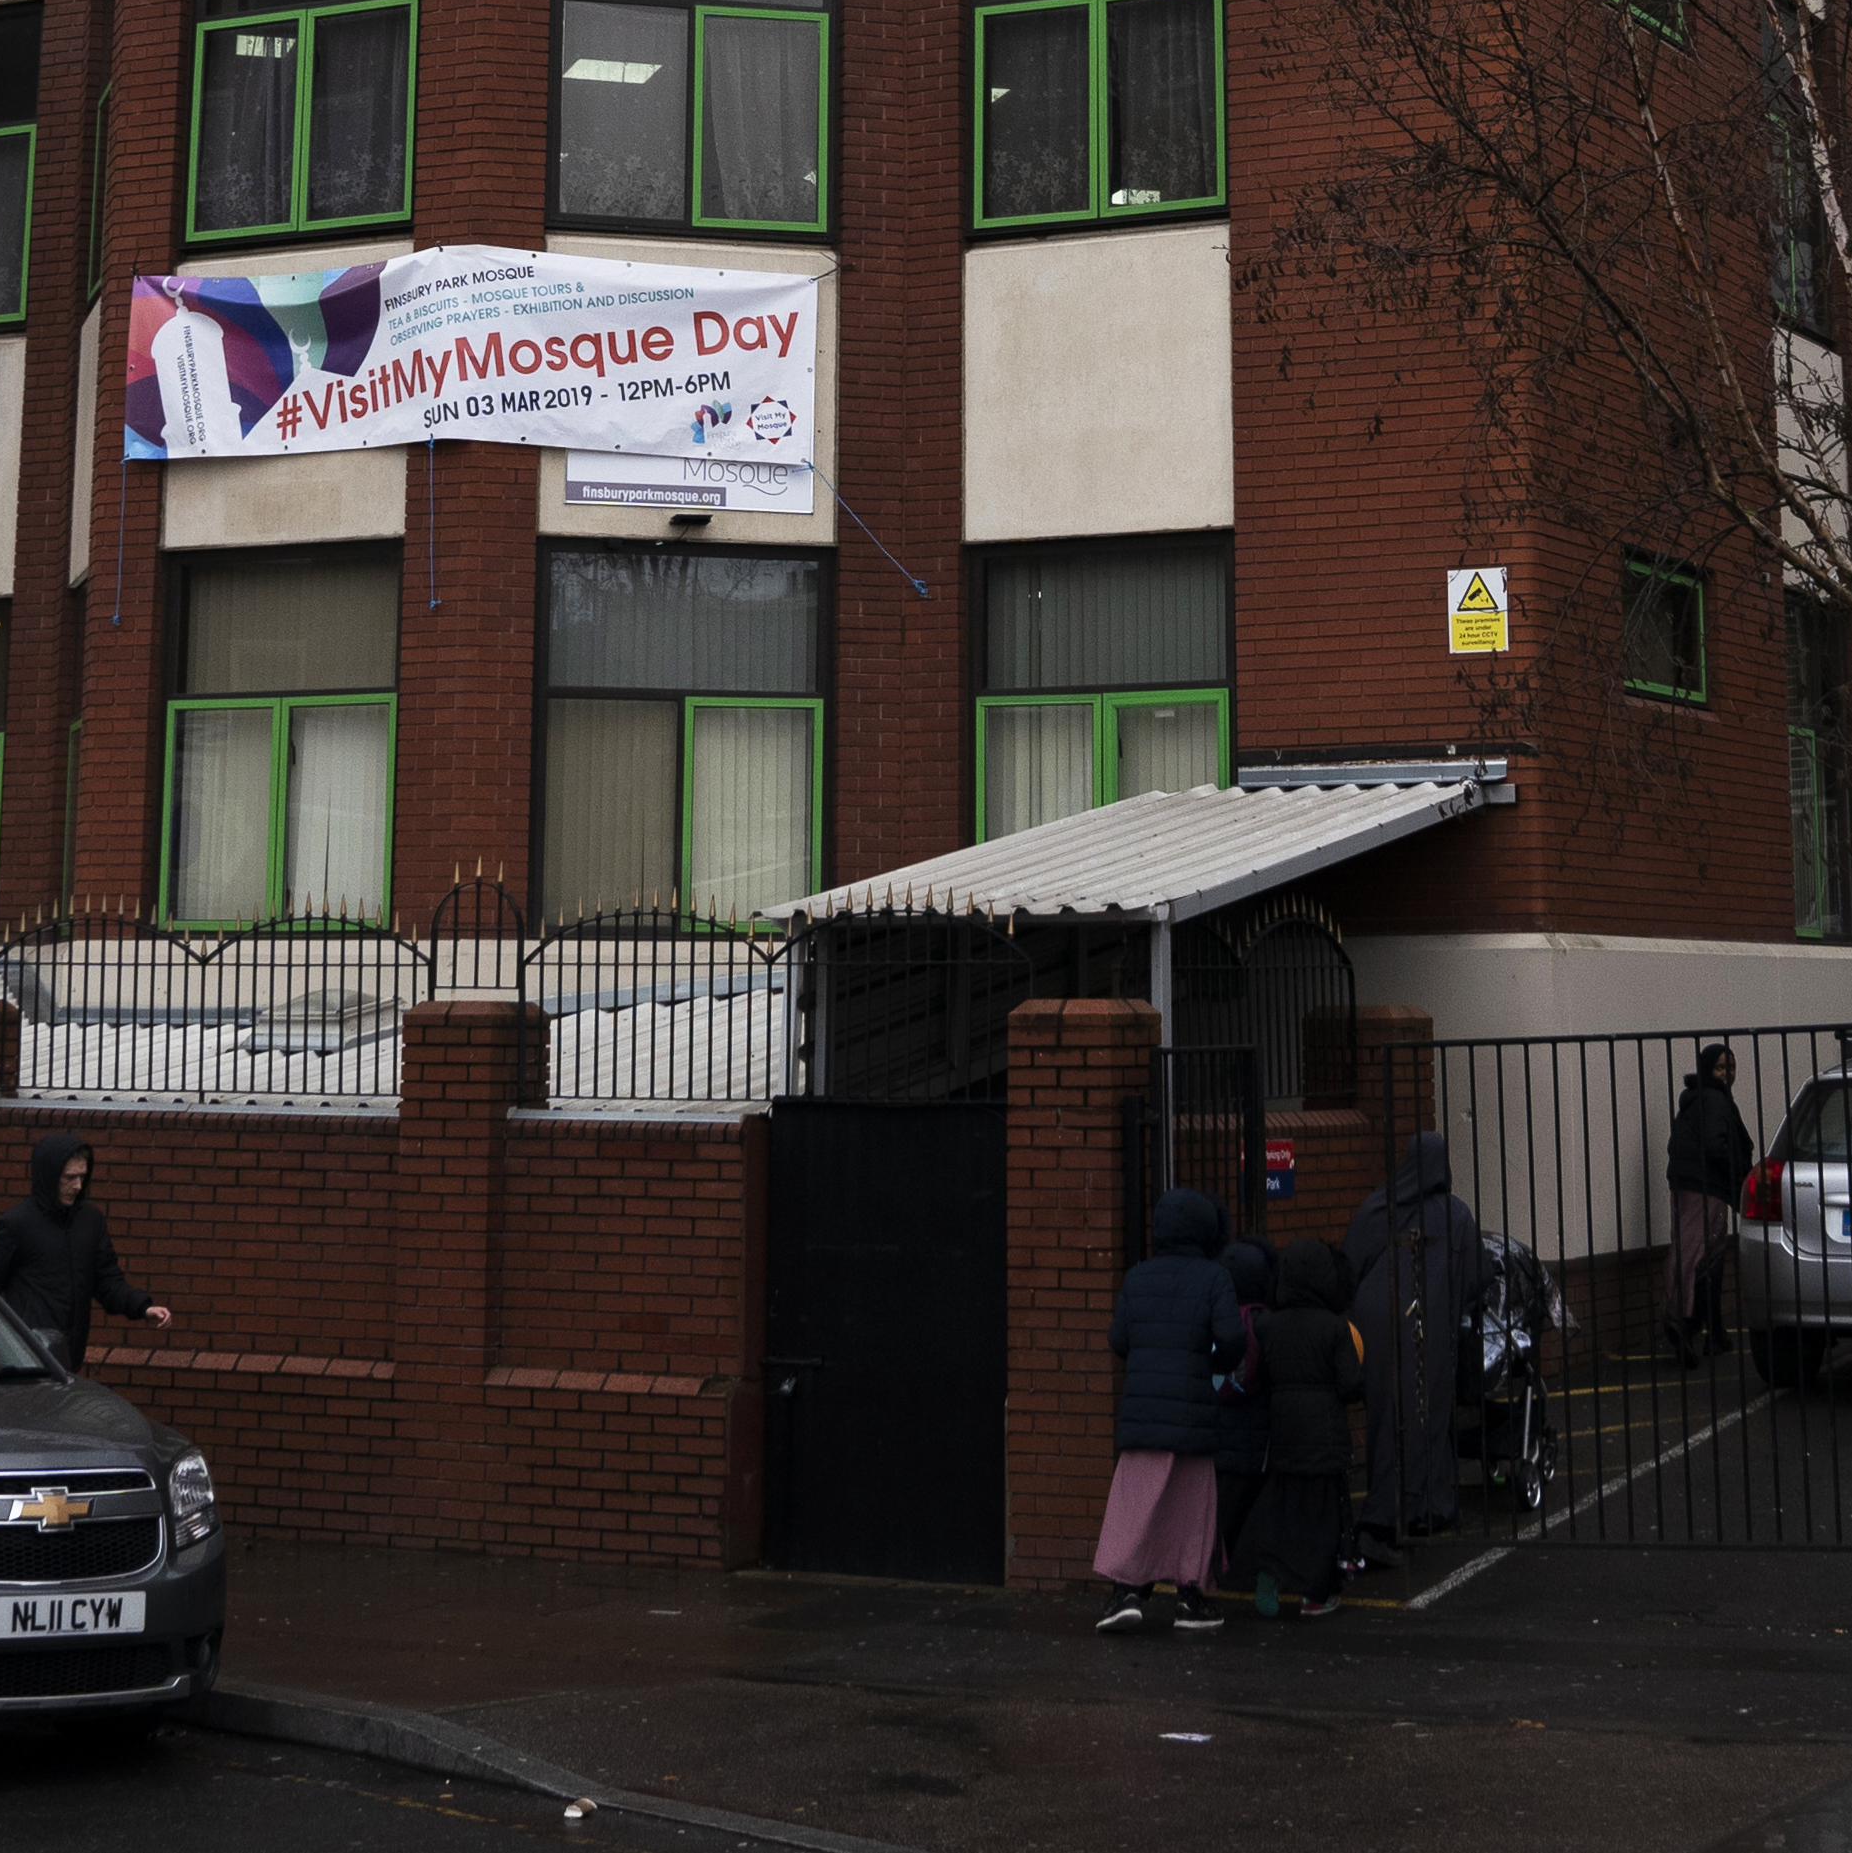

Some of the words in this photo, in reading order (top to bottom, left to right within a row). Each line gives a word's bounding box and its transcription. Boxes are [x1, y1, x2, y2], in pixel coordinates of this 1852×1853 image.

[383, 282, 433, 312] FINSBURY
[435, 274, 469, 292] PARK
[472, 265, 535, 285] MOSQUE
[388, 315, 404, 331] TEA
[405, 312, 413, 324] &
[413, 297, 460, 320] BISCUITS
[471, 287, 529, 305] MOSQUE
[531, 283, 572, 298] TOURS
[575, 281, 585, 293] &
[390, 317, 444, 346] OBSERVING
[446, 306, 501, 325] PRAYERS
[513, 298, 583, 316] EXHIBITION
[586, 295, 615, 309] AND
[618, 287, 695, 306] DISCUSSION
[276, 330, 676, 441] #VisitMyMosque
[692, 309, 800, 358] Day
[423, 401, 459, 429] SUN
[465, 394, 495, 419] 03
[500, 391, 543, 413] MAR
[543, 386, 593, 410] 2019
[617, 370, 732, 403] 12PM-6PM
[755, 413, 774, 421] Visit
[757, 421, 788, 430] Mosque
[581, 485, 721, 505] finsburyparkmosque.org
[682, 457, 789, 496] Mosque
[1266, 1176, 1280, 1190] Park
[11, 1599, 63, 1633] NL11
[71, 1597, 123, 1629] CYW
